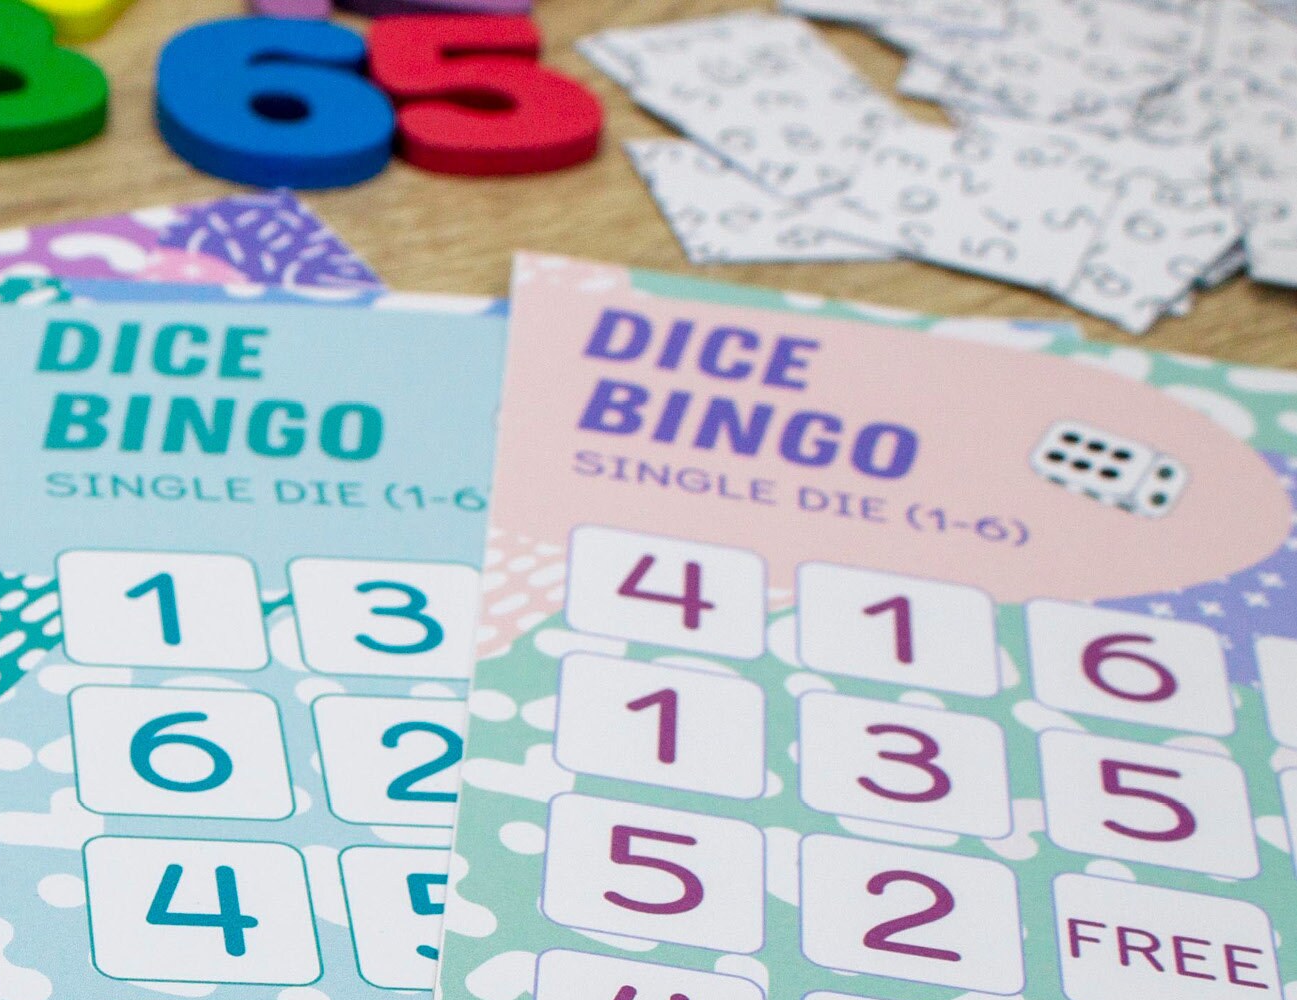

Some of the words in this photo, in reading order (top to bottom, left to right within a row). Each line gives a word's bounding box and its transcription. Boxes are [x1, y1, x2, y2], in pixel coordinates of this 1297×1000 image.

[156, 15, 395, 190] 6
[366, 14, 604, 177] 5
[36, 320, 269, 380] DICE
[583, 308, 820, 389] DICE
[42, 392, 384, 461] BINGO
[577, 378, 919, 479] BINGO
[45, 472, 253, 503] SINGLE
[274, 480, 367, 507] DIE
[384, 483, 490, 512] (1-6
[573, 450, 778, 505] SINGLE
[798, 486, 889, 523] DIE
[904, 503, 1030, 547] (1-6)
[126, 572, 182, 646] 1
[354, 580, 445, 655] 3
[617, 554, 716, 631] 4
[863, 595, 914, 665] 1
[1081, 633, 1178, 703] 6
[129, 711, 234, 793] 6
[380, 720, 464, 803] 2
[626, 688, 679, 766] 1
[857, 723, 953, 805] 3
[1099, 758, 1197, 842] 5
[145, 863, 260, 957] 4
[602, 824, 705, 915] 5
[862, 869, 962, 963] 2
[1067, 918, 1269, 990] FREE
